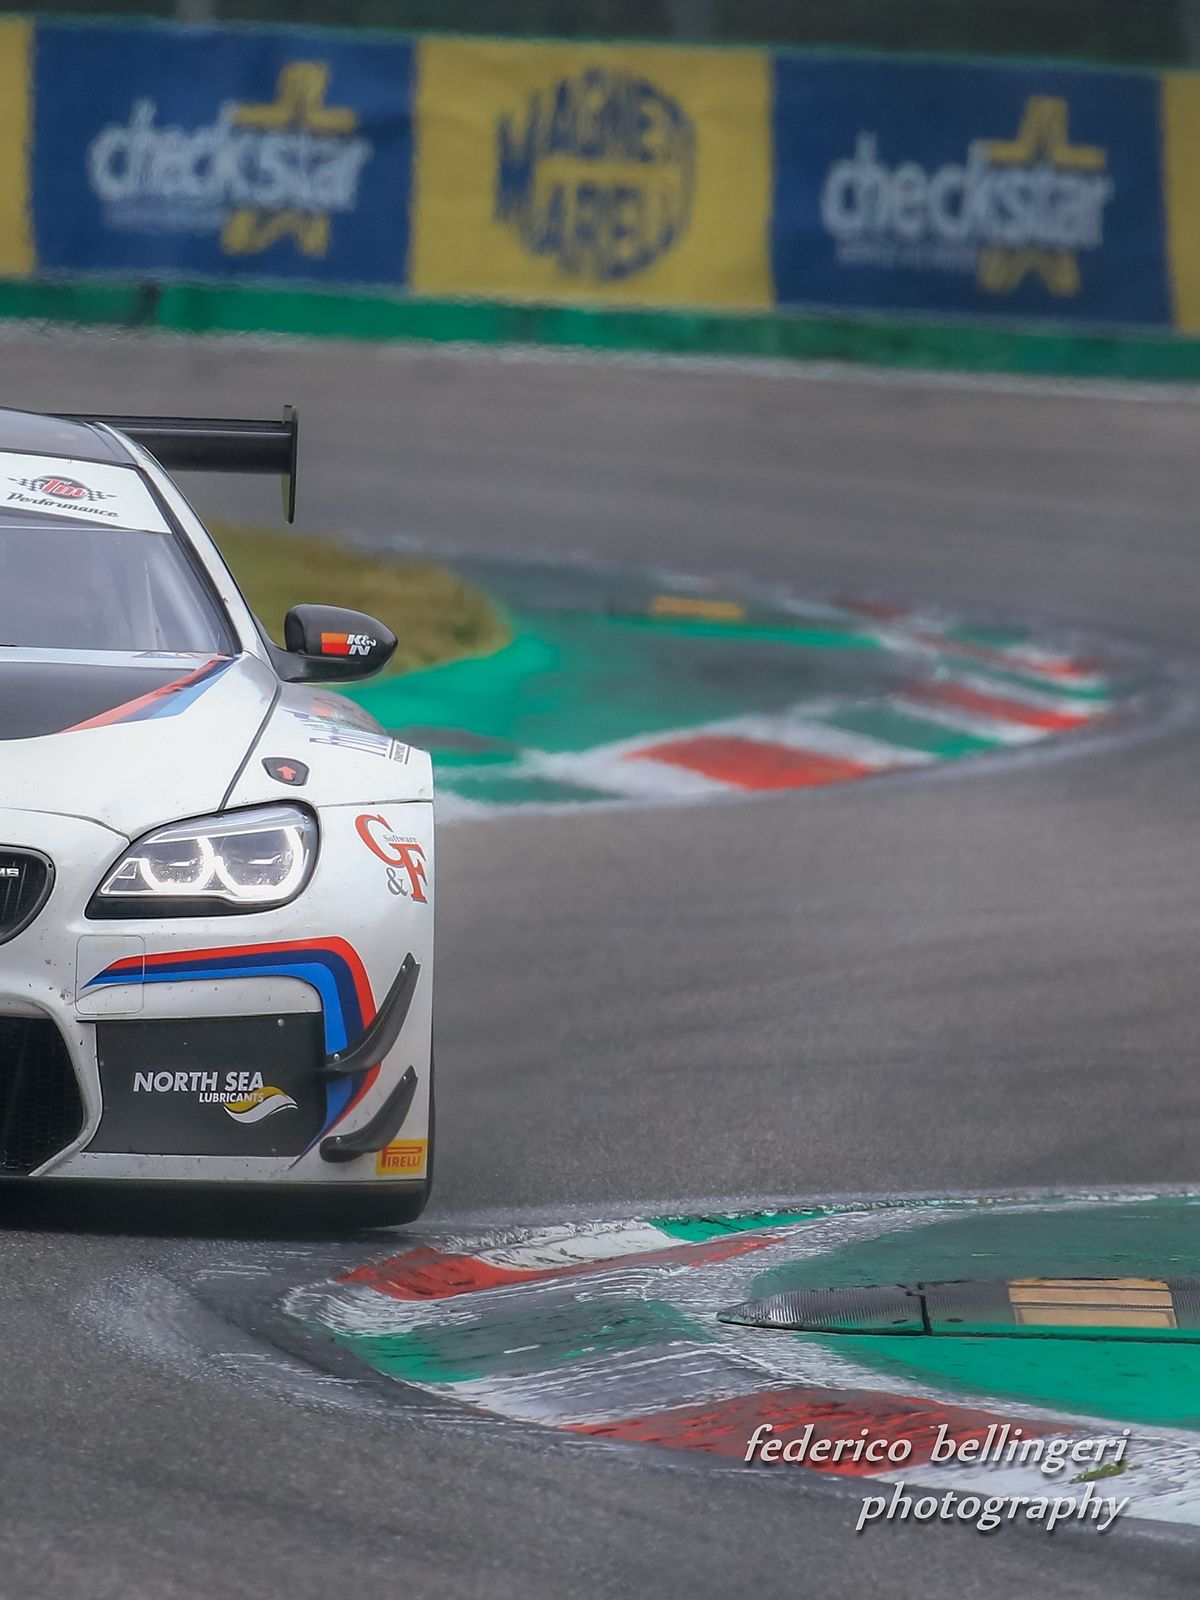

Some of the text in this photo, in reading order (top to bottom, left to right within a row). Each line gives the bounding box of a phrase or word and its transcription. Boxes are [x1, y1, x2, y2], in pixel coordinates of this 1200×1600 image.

[6, 491, 120, 517] Performance
[133, 1071, 264, 1092] NORTH SEA
[199, 1092, 264, 1103] LUBRICANTS
[381, 1146, 422, 1168] PIRELLI
